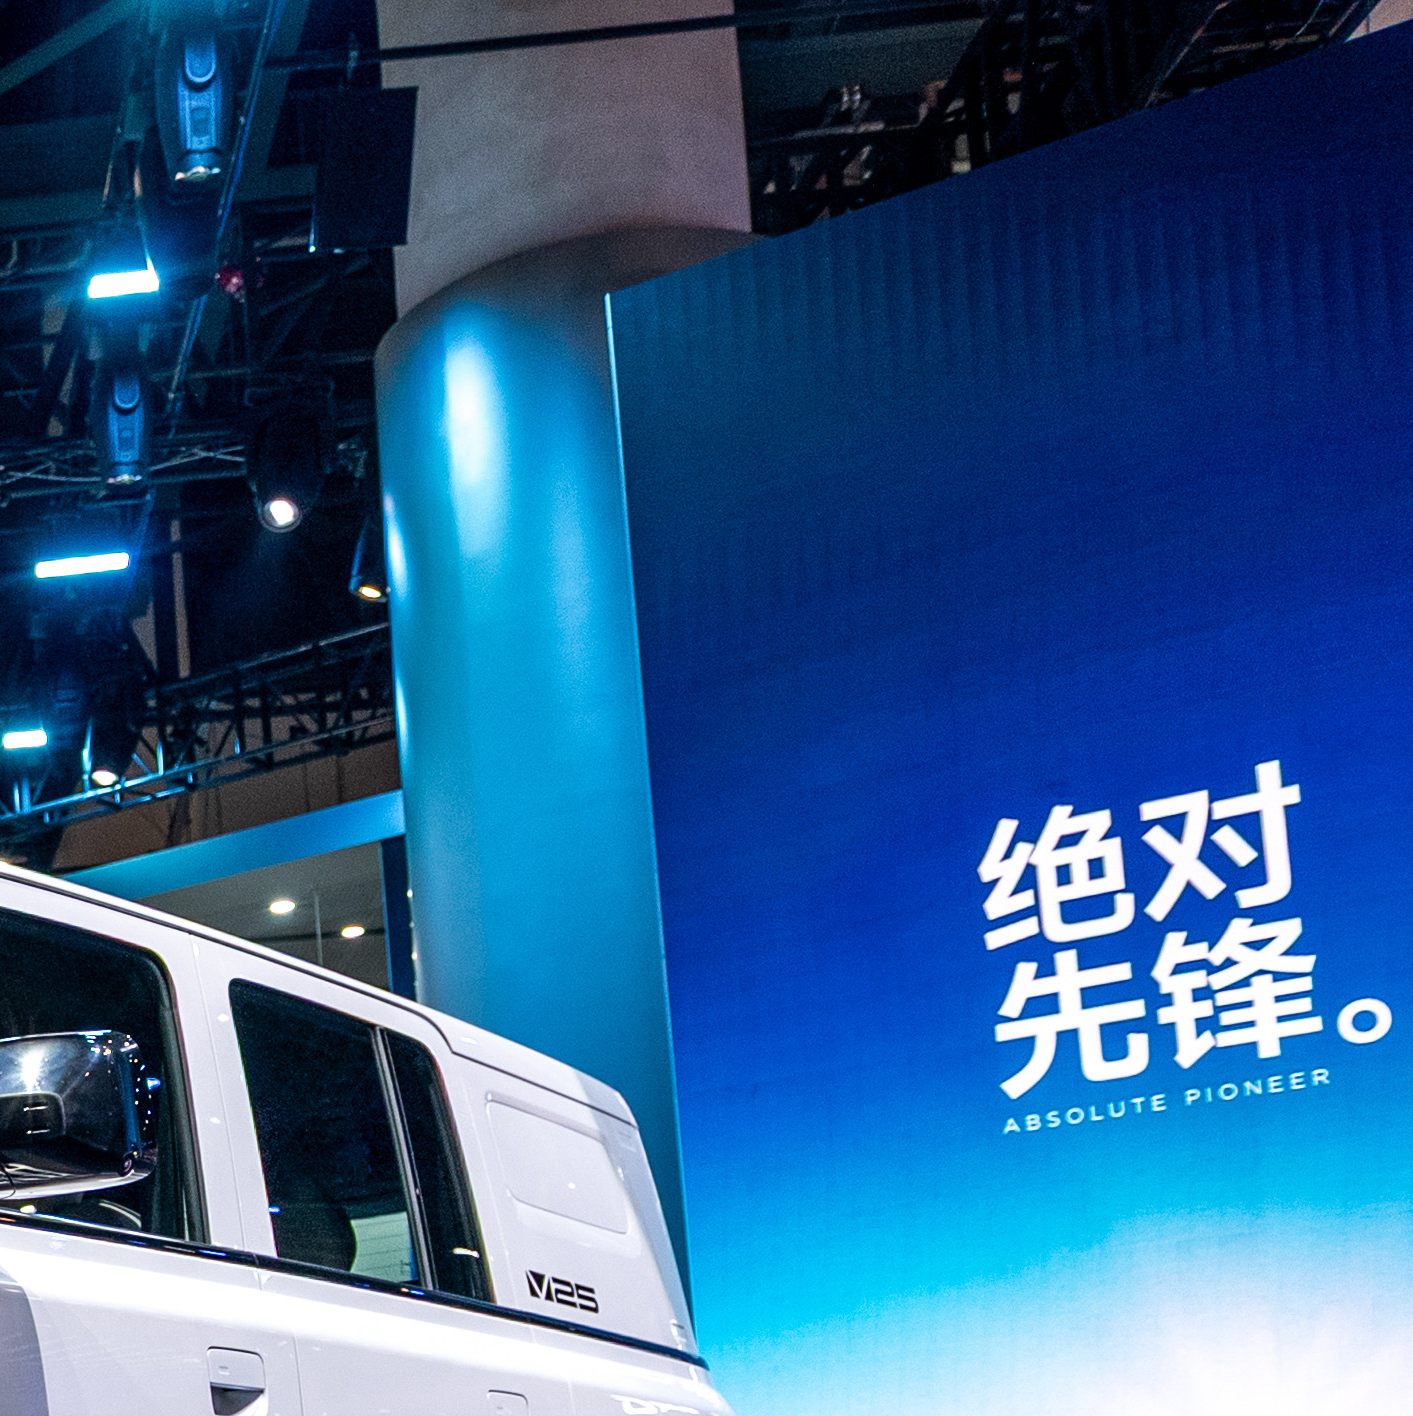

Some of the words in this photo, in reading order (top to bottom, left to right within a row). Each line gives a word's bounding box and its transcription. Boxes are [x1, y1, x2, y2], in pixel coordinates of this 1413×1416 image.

[977, 759, 1301, 951] 绝对
[1002, 1094, 1167, 1135] ABSOLUTE
[1185, 1068, 1331, 1106] PIONEER
[526, 1269, 599, 1314] V25
